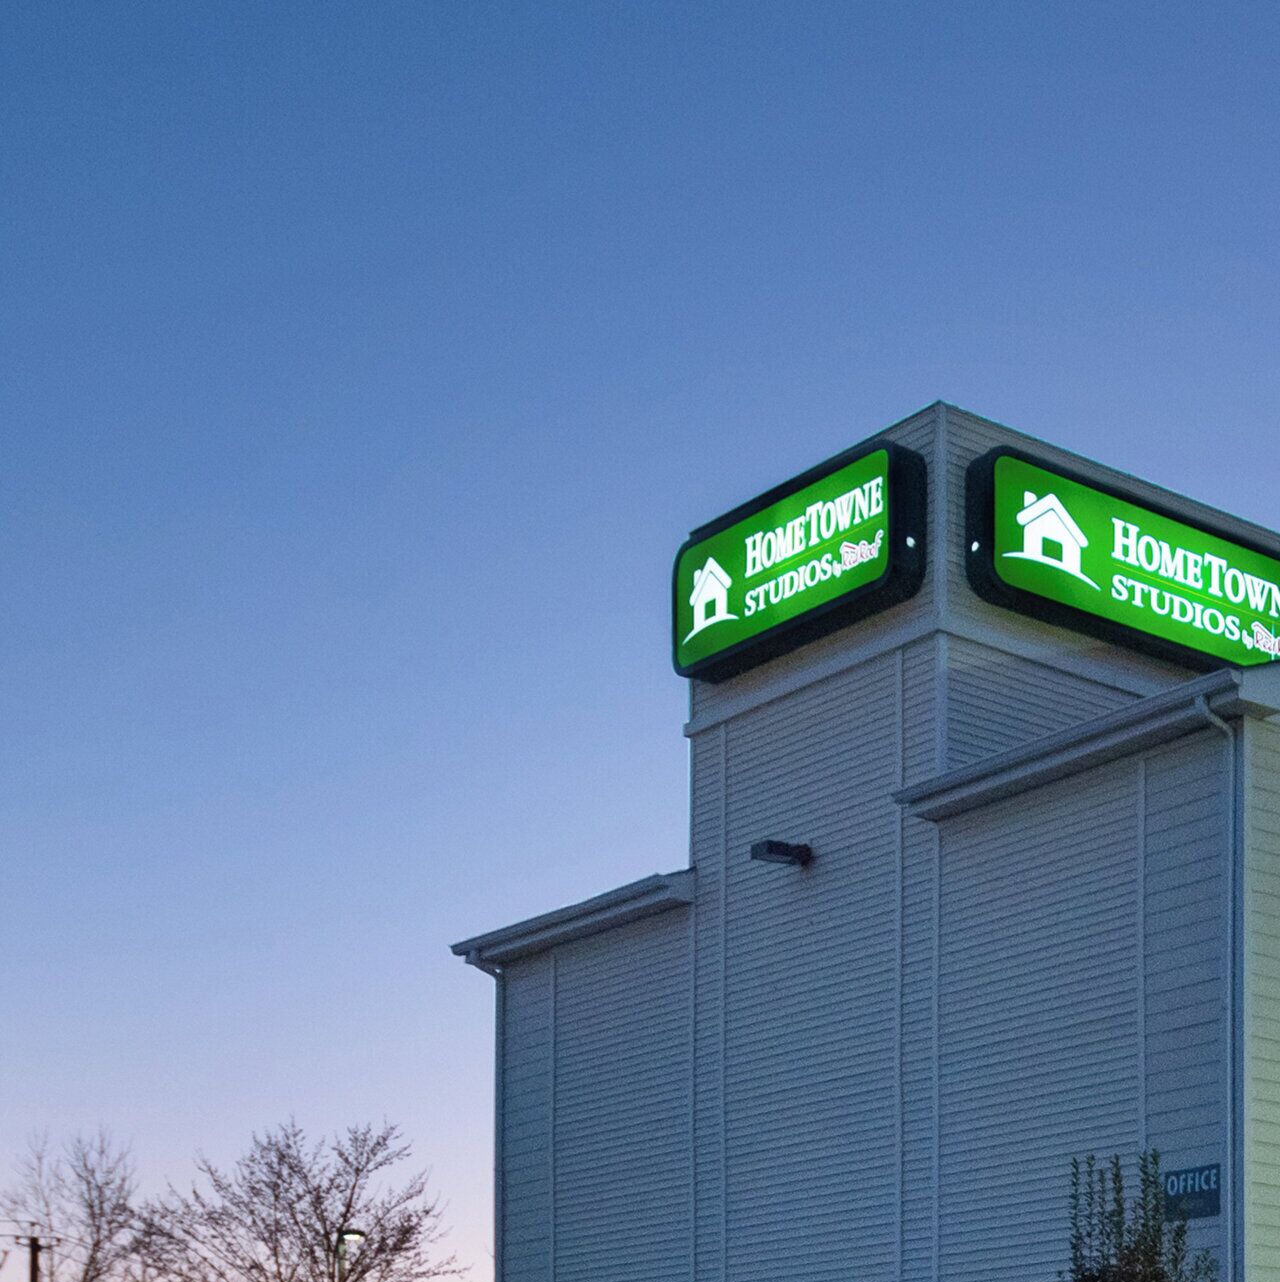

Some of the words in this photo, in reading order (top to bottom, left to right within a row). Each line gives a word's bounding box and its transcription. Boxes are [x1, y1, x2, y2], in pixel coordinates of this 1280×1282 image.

[744, 553, 833, 617] STUDIOS
[1111, 574, 1241, 642] STUDIOS
[1167, 1169, 1217, 1196] OFFICE
